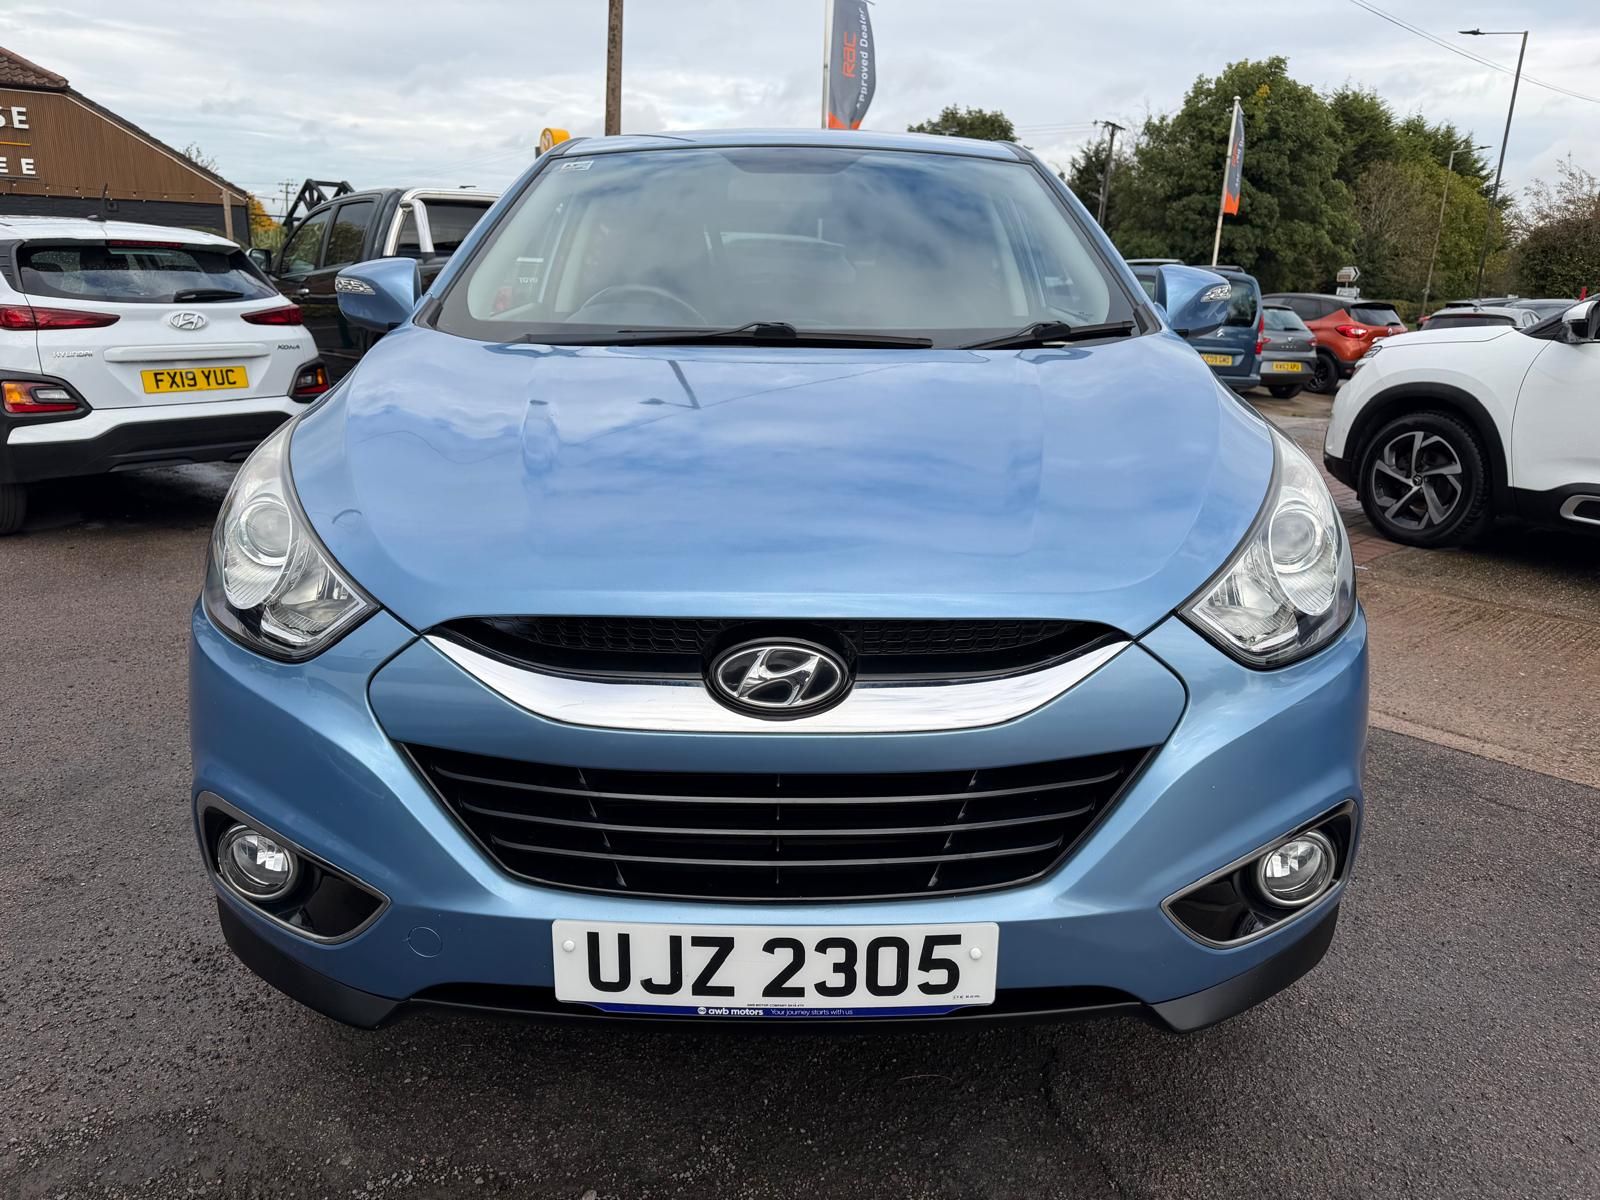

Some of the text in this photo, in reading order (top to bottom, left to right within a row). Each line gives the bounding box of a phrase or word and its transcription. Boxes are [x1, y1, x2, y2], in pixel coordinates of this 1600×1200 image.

[856, 7, 869, 109] pproved Dealer
[153, 369, 237, 389] FX19 YUC
[586, 931, 962, 998] UJZ 2305
[708, 1007, 764, 1016] awb motors
[770, 1008, 785, 1016] Your
[785, 1009, 810, 1017] journey
[811, 1008, 829, 1016] starts
[830, 1008, 844, 1016] with
